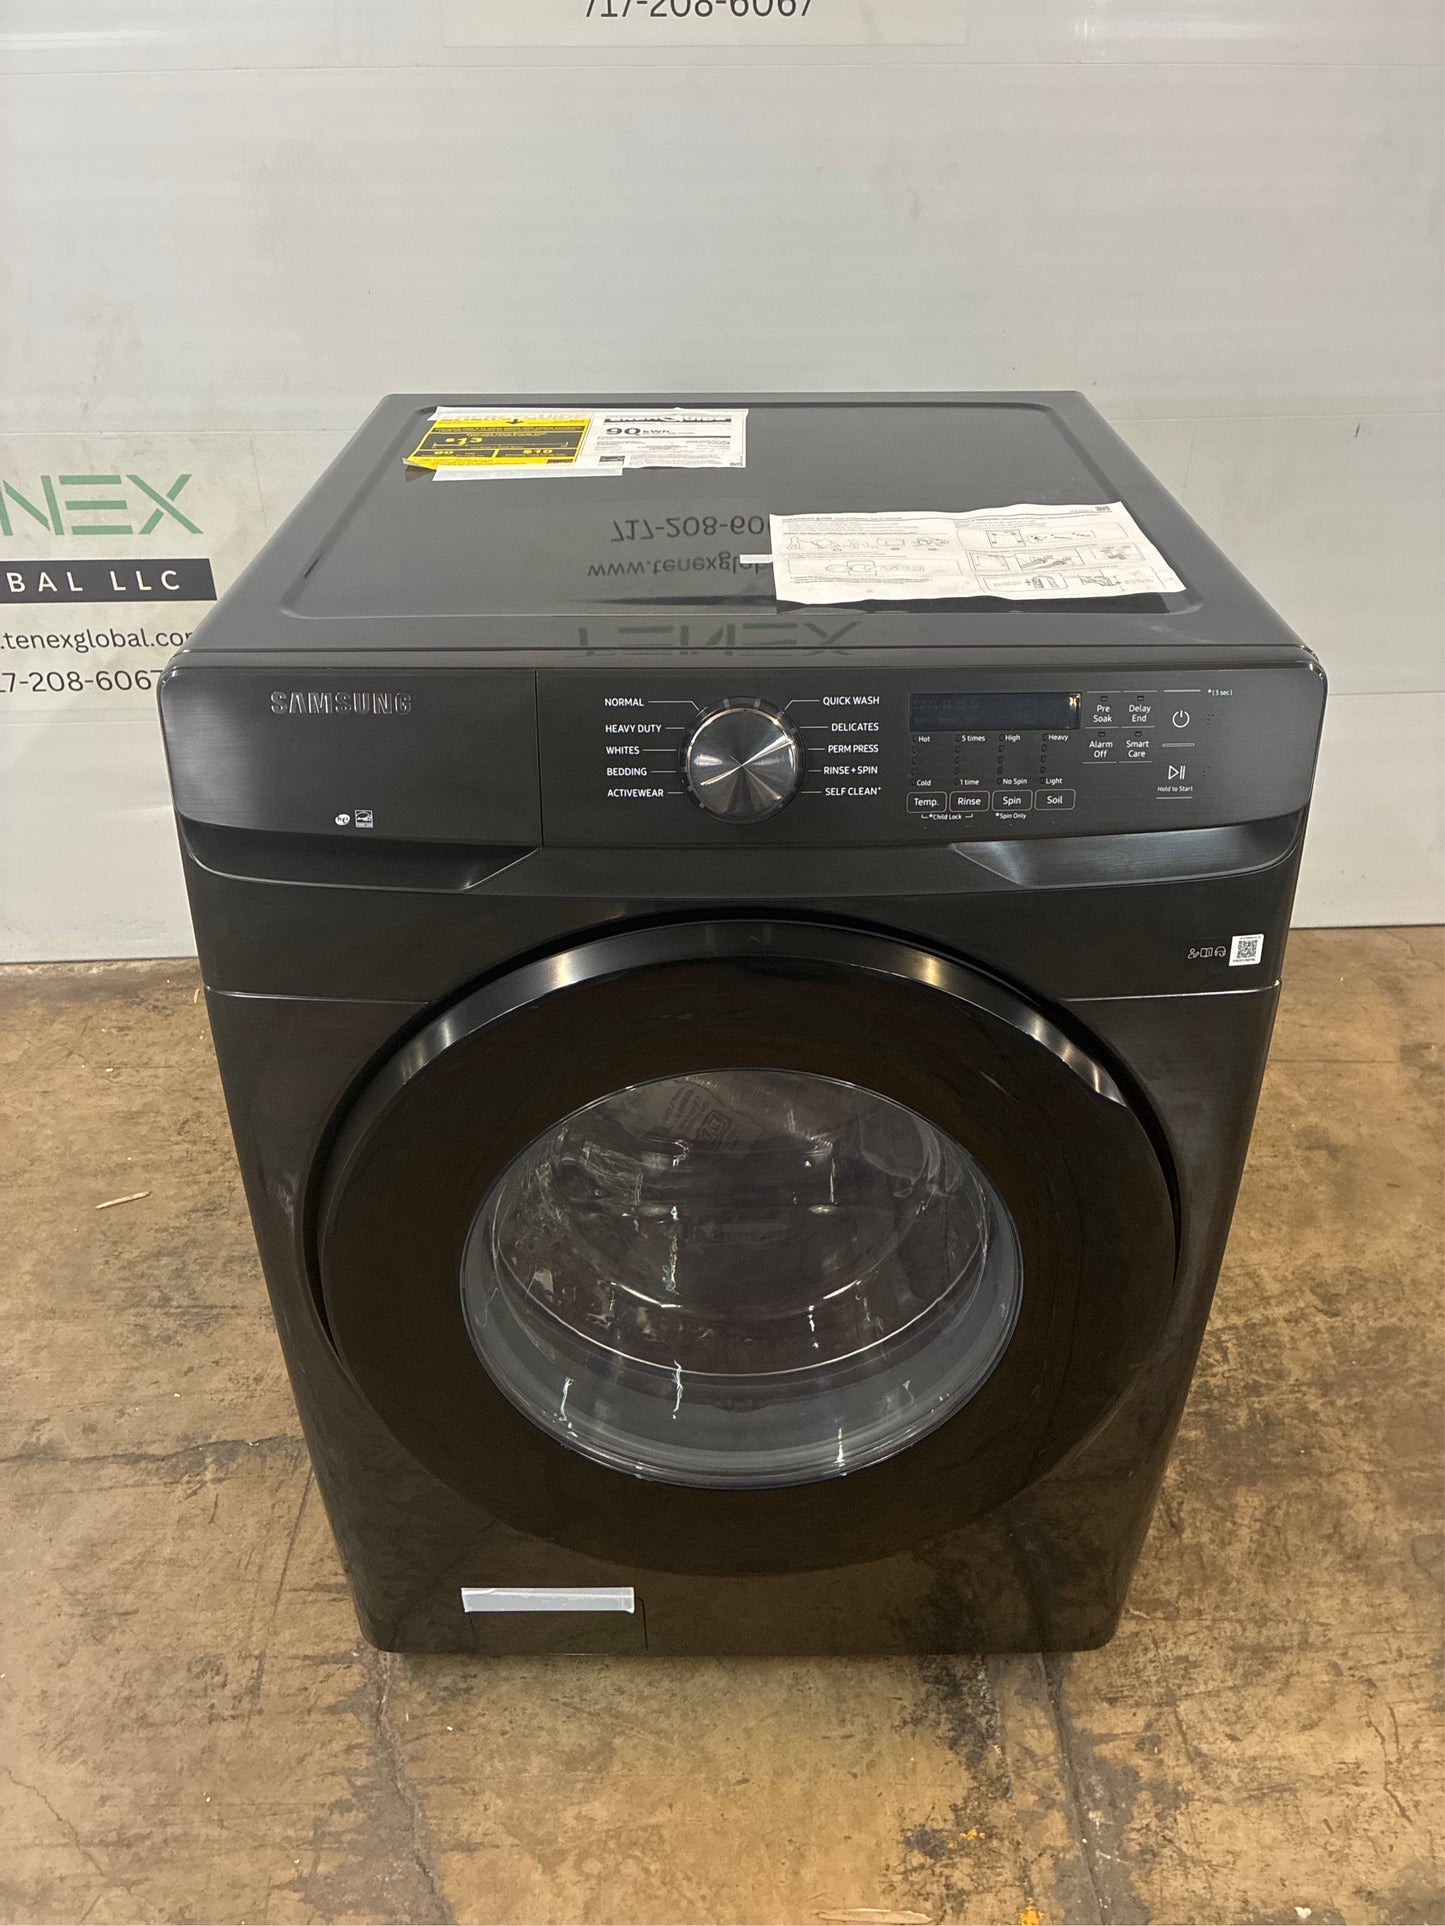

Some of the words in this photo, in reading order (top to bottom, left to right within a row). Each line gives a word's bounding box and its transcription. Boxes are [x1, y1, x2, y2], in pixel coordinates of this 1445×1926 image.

[585, 0, 812, 18] 717-208-6067
[0, 474, 204, 536] NEX
[6, 571, 84, 593] BAL
[110, 570, 181, 591] LLC
[0, 628, 193, 653] .tenexglobal.co
[0, 670, 163, 692] 7-208-606
[270, 690, 412, 715] SAMSUNG
[604, 698, 644, 706] NORMAL
[822, 696, 851, 706] QUICK
[852, 696, 880, 705] WASH
[1096, 704, 1110, 712] Pre
[1128, 704, 1152, 714] Delay
[1092, 714, 1112, 722] Soak
[1132, 714, 1147, 722] End
[605, 724, 636, 733] HEAVY
[638, 724, 662, 733] DUTY
[831, 722, 880, 732] DELICATES
[1004, 734, 1021, 742] High
[1048, 734, 1069, 742] Heavy
[1088, 740, 1114, 748] Alarm
[1126, 740, 1150, 748] Smart
[605, 746, 640, 755] WHITES
[828, 744, 852, 754] PERM
[852, 744, 879, 753] PRESS
[1094, 750, 1108, 758] Off
[1128, 750, 1146, 758] Care
[606, 767, 648, 776] BEDDING
[964, 778, 980, 786] time
[1013, 778, 1028, 786] Spin
[1046, 777, 1063, 786] Light
[607, 788, 664, 798] ACTIVEWEAR
[825, 787, 846, 796] SELF
[914, 797, 940, 808] Temp.
[958, 796, 982, 806] Rinse
[1002, 796, 1022, 807] Spin
[1046, 795, 1063, 804] Soil
[1012, 812, 1027, 820] Only
